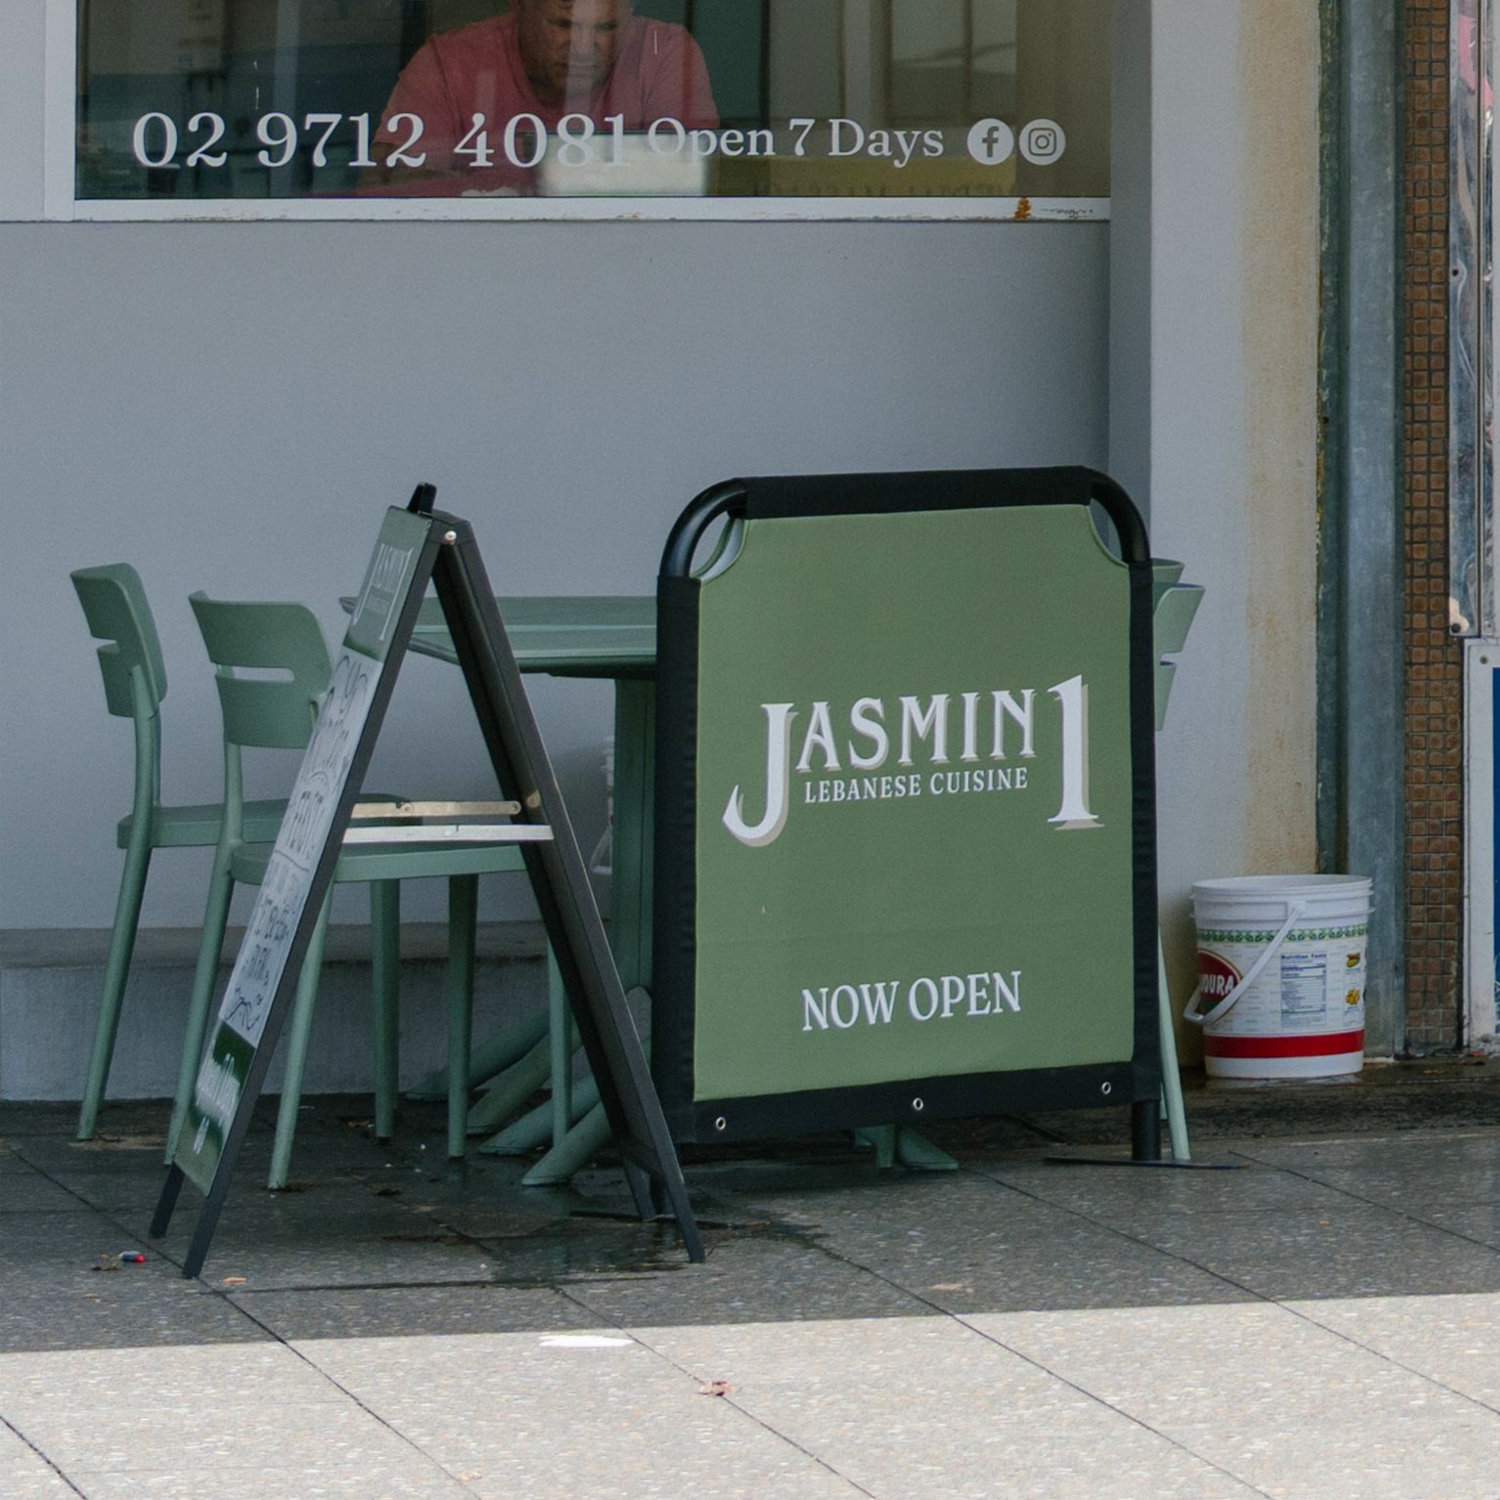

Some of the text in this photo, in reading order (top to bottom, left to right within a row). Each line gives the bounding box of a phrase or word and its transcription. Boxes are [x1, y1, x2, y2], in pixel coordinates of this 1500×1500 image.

[132, 111, 627, 168] 02 9712 4081
[648, 117, 944, 170] Open 7 Days
[804, 766, 1029, 805] LEBANESE CUISINE
[801, 970, 1022, 1035] NOW OPEN
